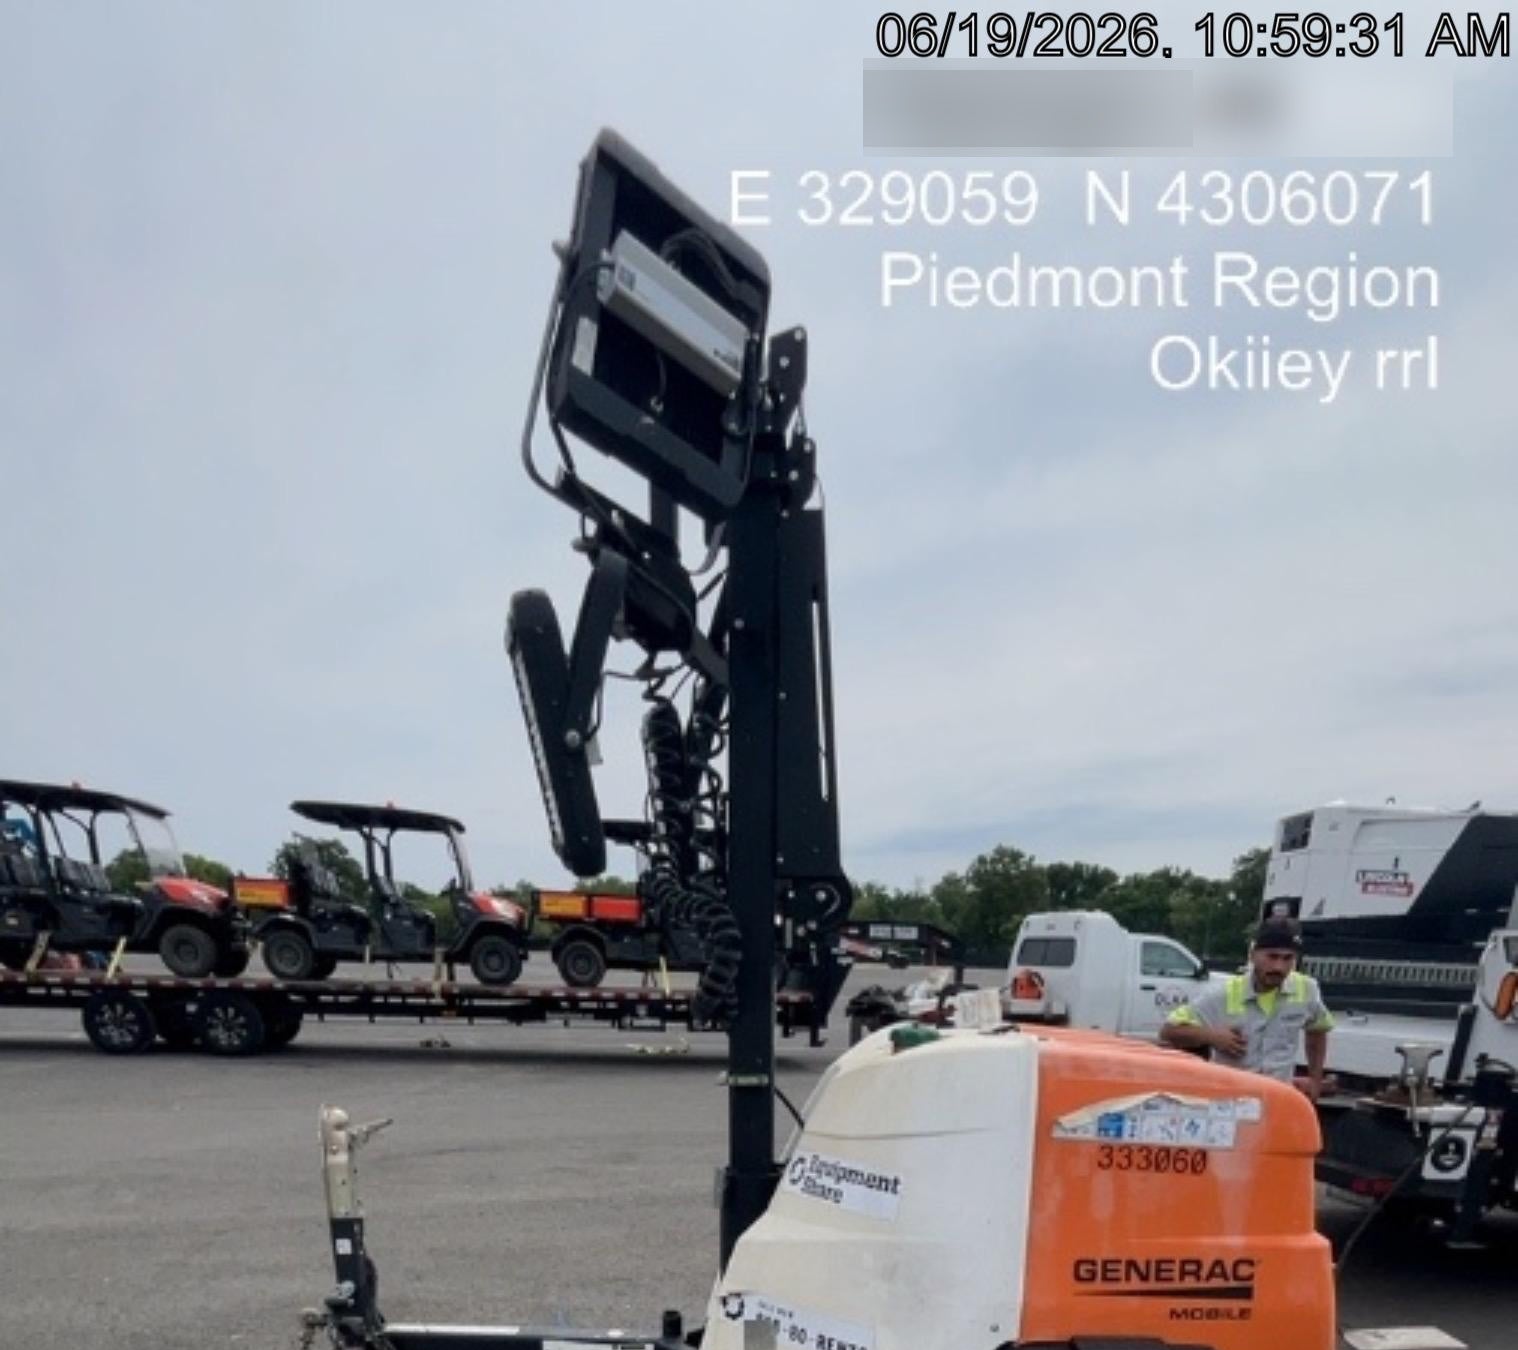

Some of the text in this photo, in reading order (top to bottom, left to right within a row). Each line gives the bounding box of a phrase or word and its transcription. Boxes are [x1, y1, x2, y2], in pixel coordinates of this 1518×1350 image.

[808, 1153, 902, 1195] Equipment
[1097, 1145, 1208, 1175] 333060
[1073, 1258, 1256, 1284] GENERAC
[1168, 1307, 1253, 1322] MOBILE
